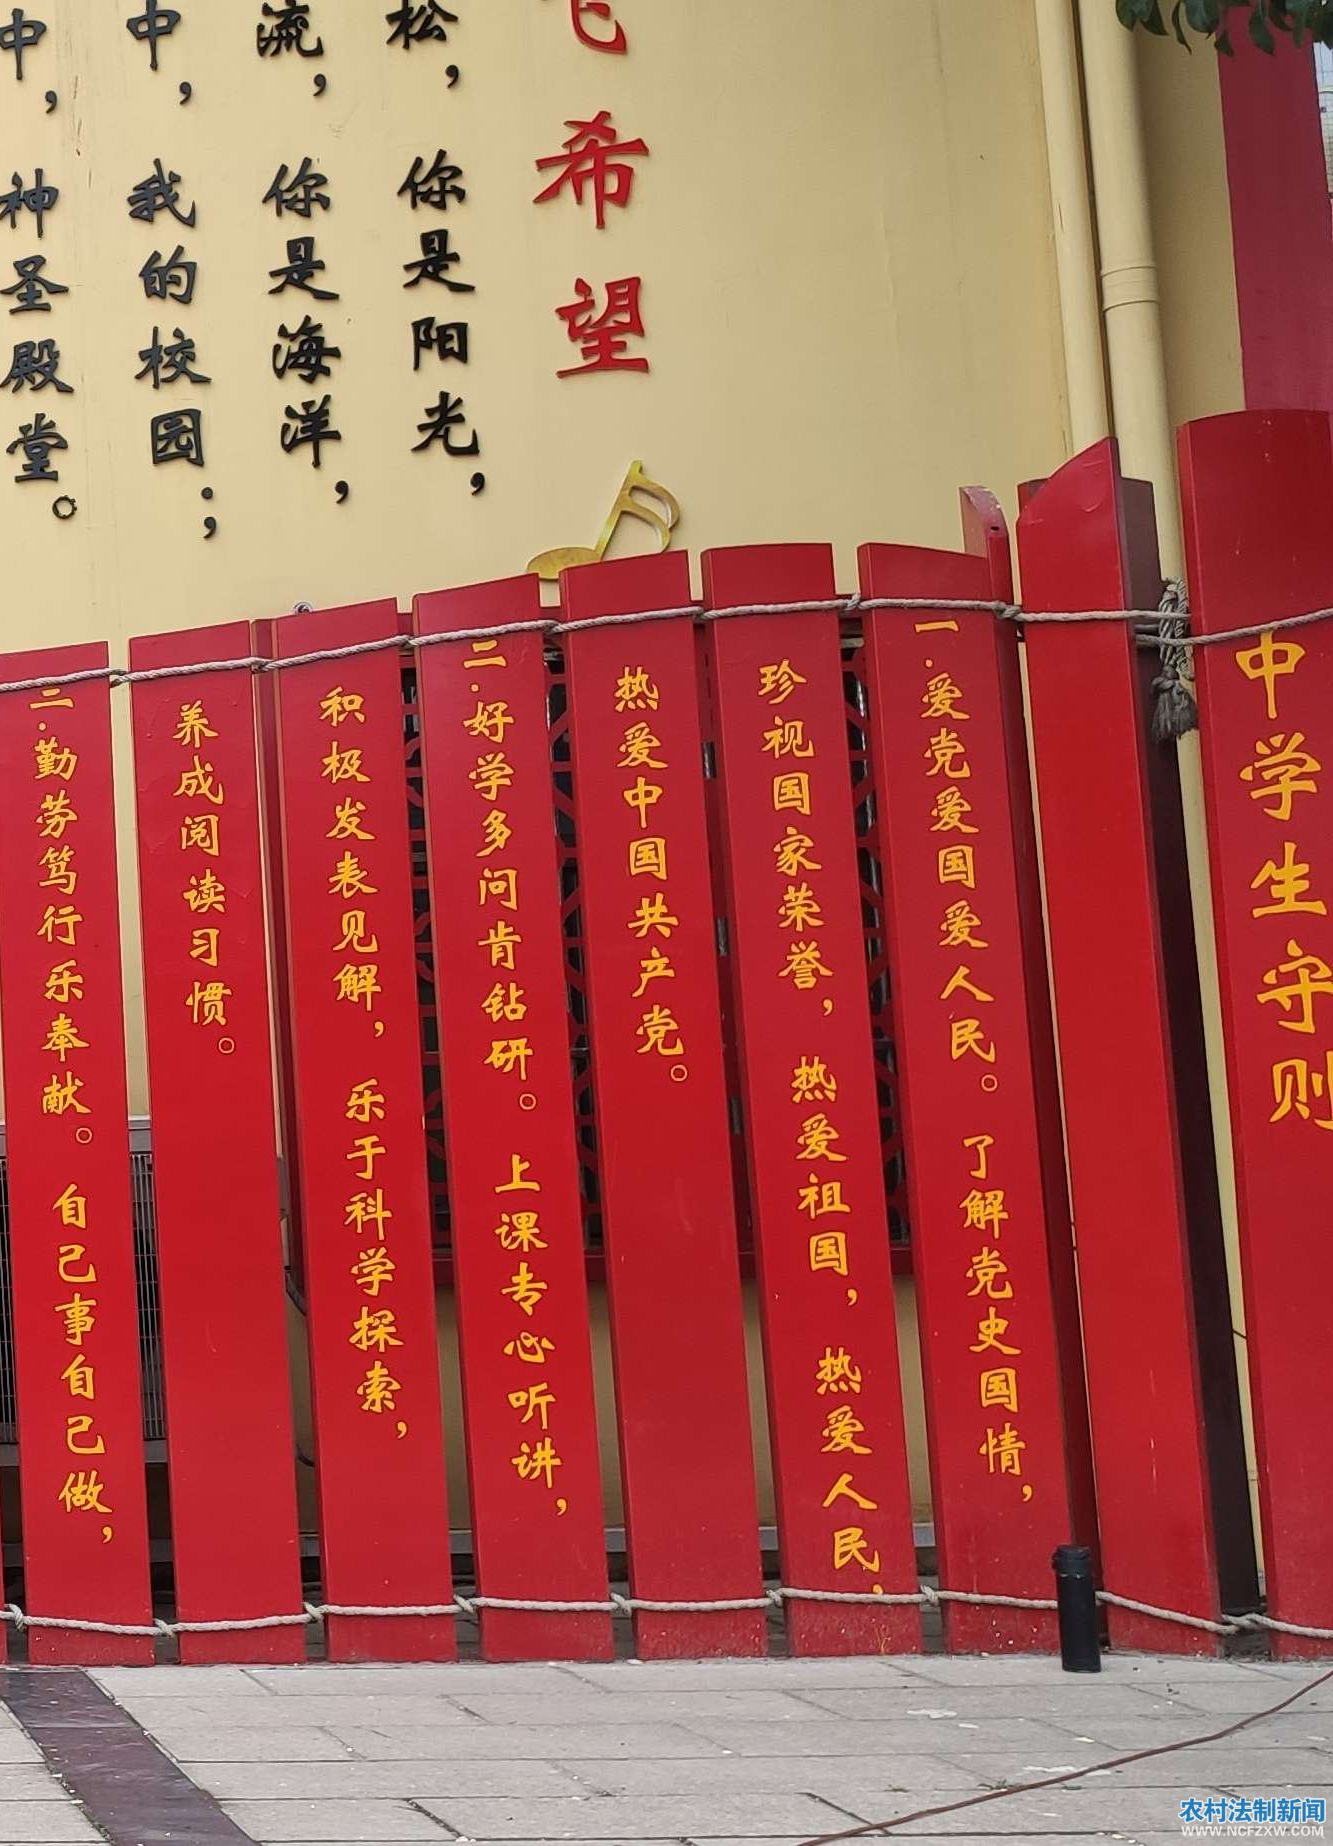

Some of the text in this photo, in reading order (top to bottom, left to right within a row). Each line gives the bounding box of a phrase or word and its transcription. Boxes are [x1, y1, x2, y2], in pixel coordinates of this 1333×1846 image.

[173, 701, 234, 1053] 养成阅读习惯。
[616, 667, 687, 1081] 热爱中国共产党。
[1236, 634, 1333, 1130] 中学生守则
